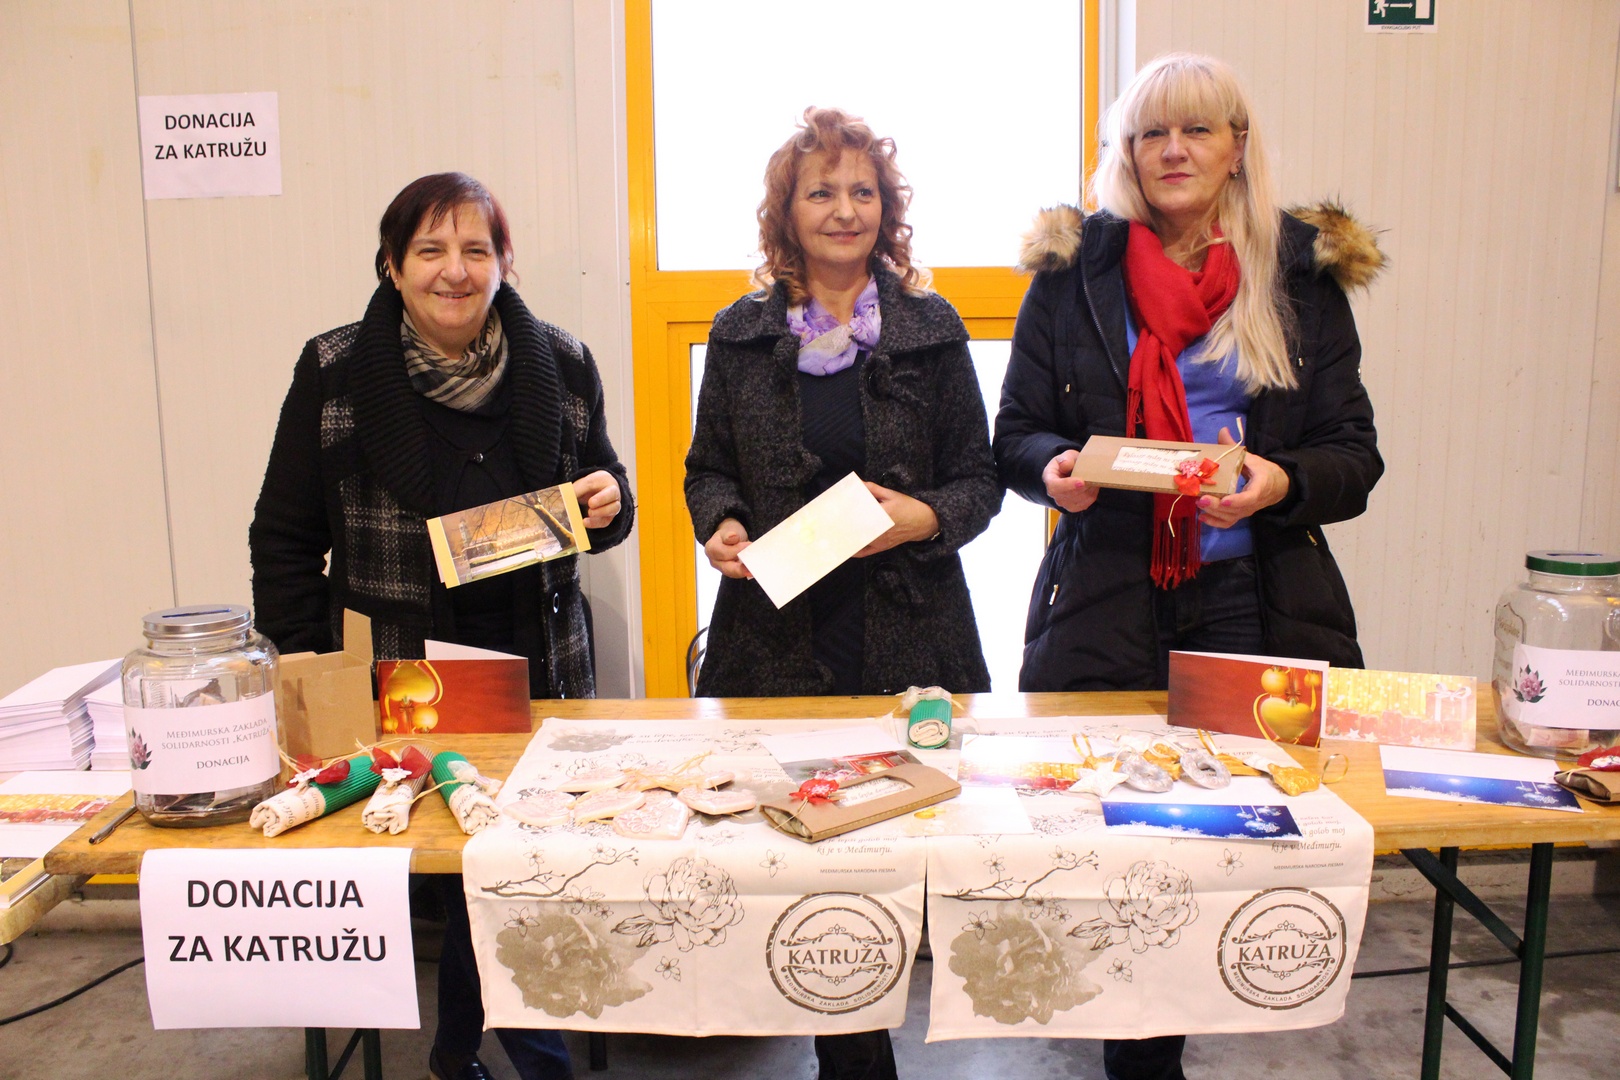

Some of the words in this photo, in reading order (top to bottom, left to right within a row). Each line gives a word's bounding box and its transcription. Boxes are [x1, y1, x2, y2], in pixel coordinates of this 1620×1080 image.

[165, 112, 256, 130] DONACIJA
[155, 145, 178, 160] ZA
[184, 137, 267, 159] KATRUŽU
[233, 718, 267, 732] ZAKLADA
[162, 738, 230, 750] SOLIDARNOSTI
[196, 755, 250, 769] DONACIJA
[188, 880, 364, 908] DONACIJA
[168, 935, 213, 962] ZA
[224, 928, 386, 962] KATRUŽU
[788, 943, 888, 965] KATRUŽA
[1239, 939, 1331, 962] KATRUŽA
[1263, 994, 1293, 1002] ZAKLADA
